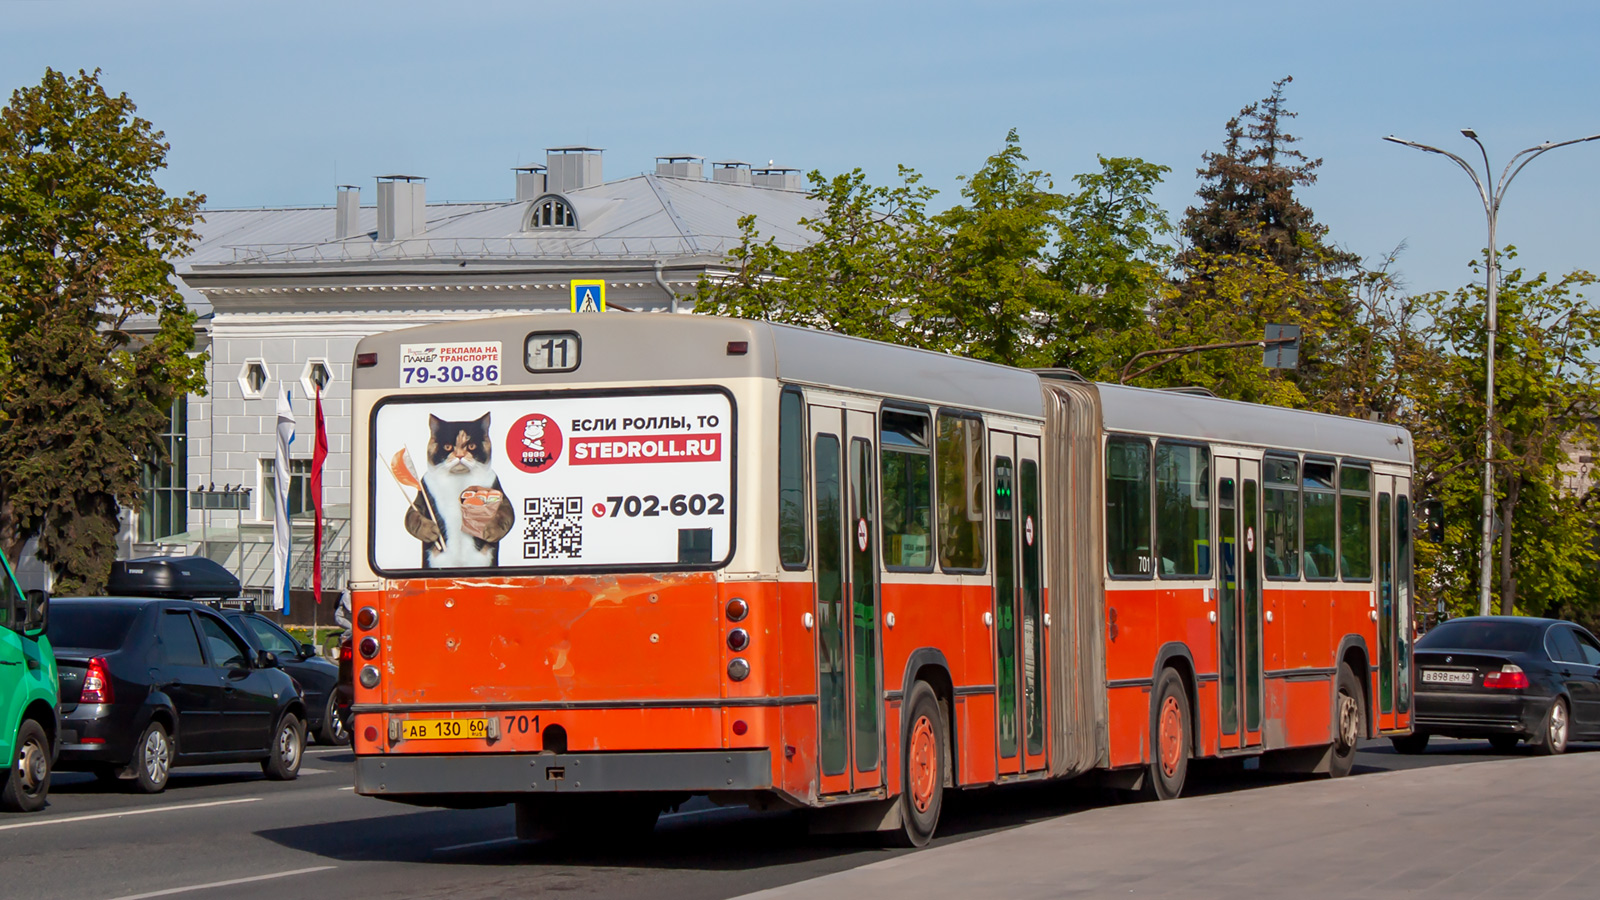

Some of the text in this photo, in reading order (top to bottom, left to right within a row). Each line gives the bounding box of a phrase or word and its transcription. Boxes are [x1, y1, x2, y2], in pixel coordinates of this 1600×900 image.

[439, 353, 499, 363] ТРАНСПОРТЕ
[440, 346, 483, 354] РЕКЛАМА
[541, 339, 568, 368] 11
[403, 365, 499, 384] 79-30-86
[571, 415, 720, 432] ЕСЛИ РОЛЛЫ, ТО
[574, 439, 716, 459] STEDROLL.RU
[606, 493, 725, 518] 702-602
[1138, 556, 1150, 573] 701
[1432, 672, 1448, 681] 898
[435, 722, 461, 736] 130
[469, 720, 484, 731] 60
[505, 715, 540, 734] 701
